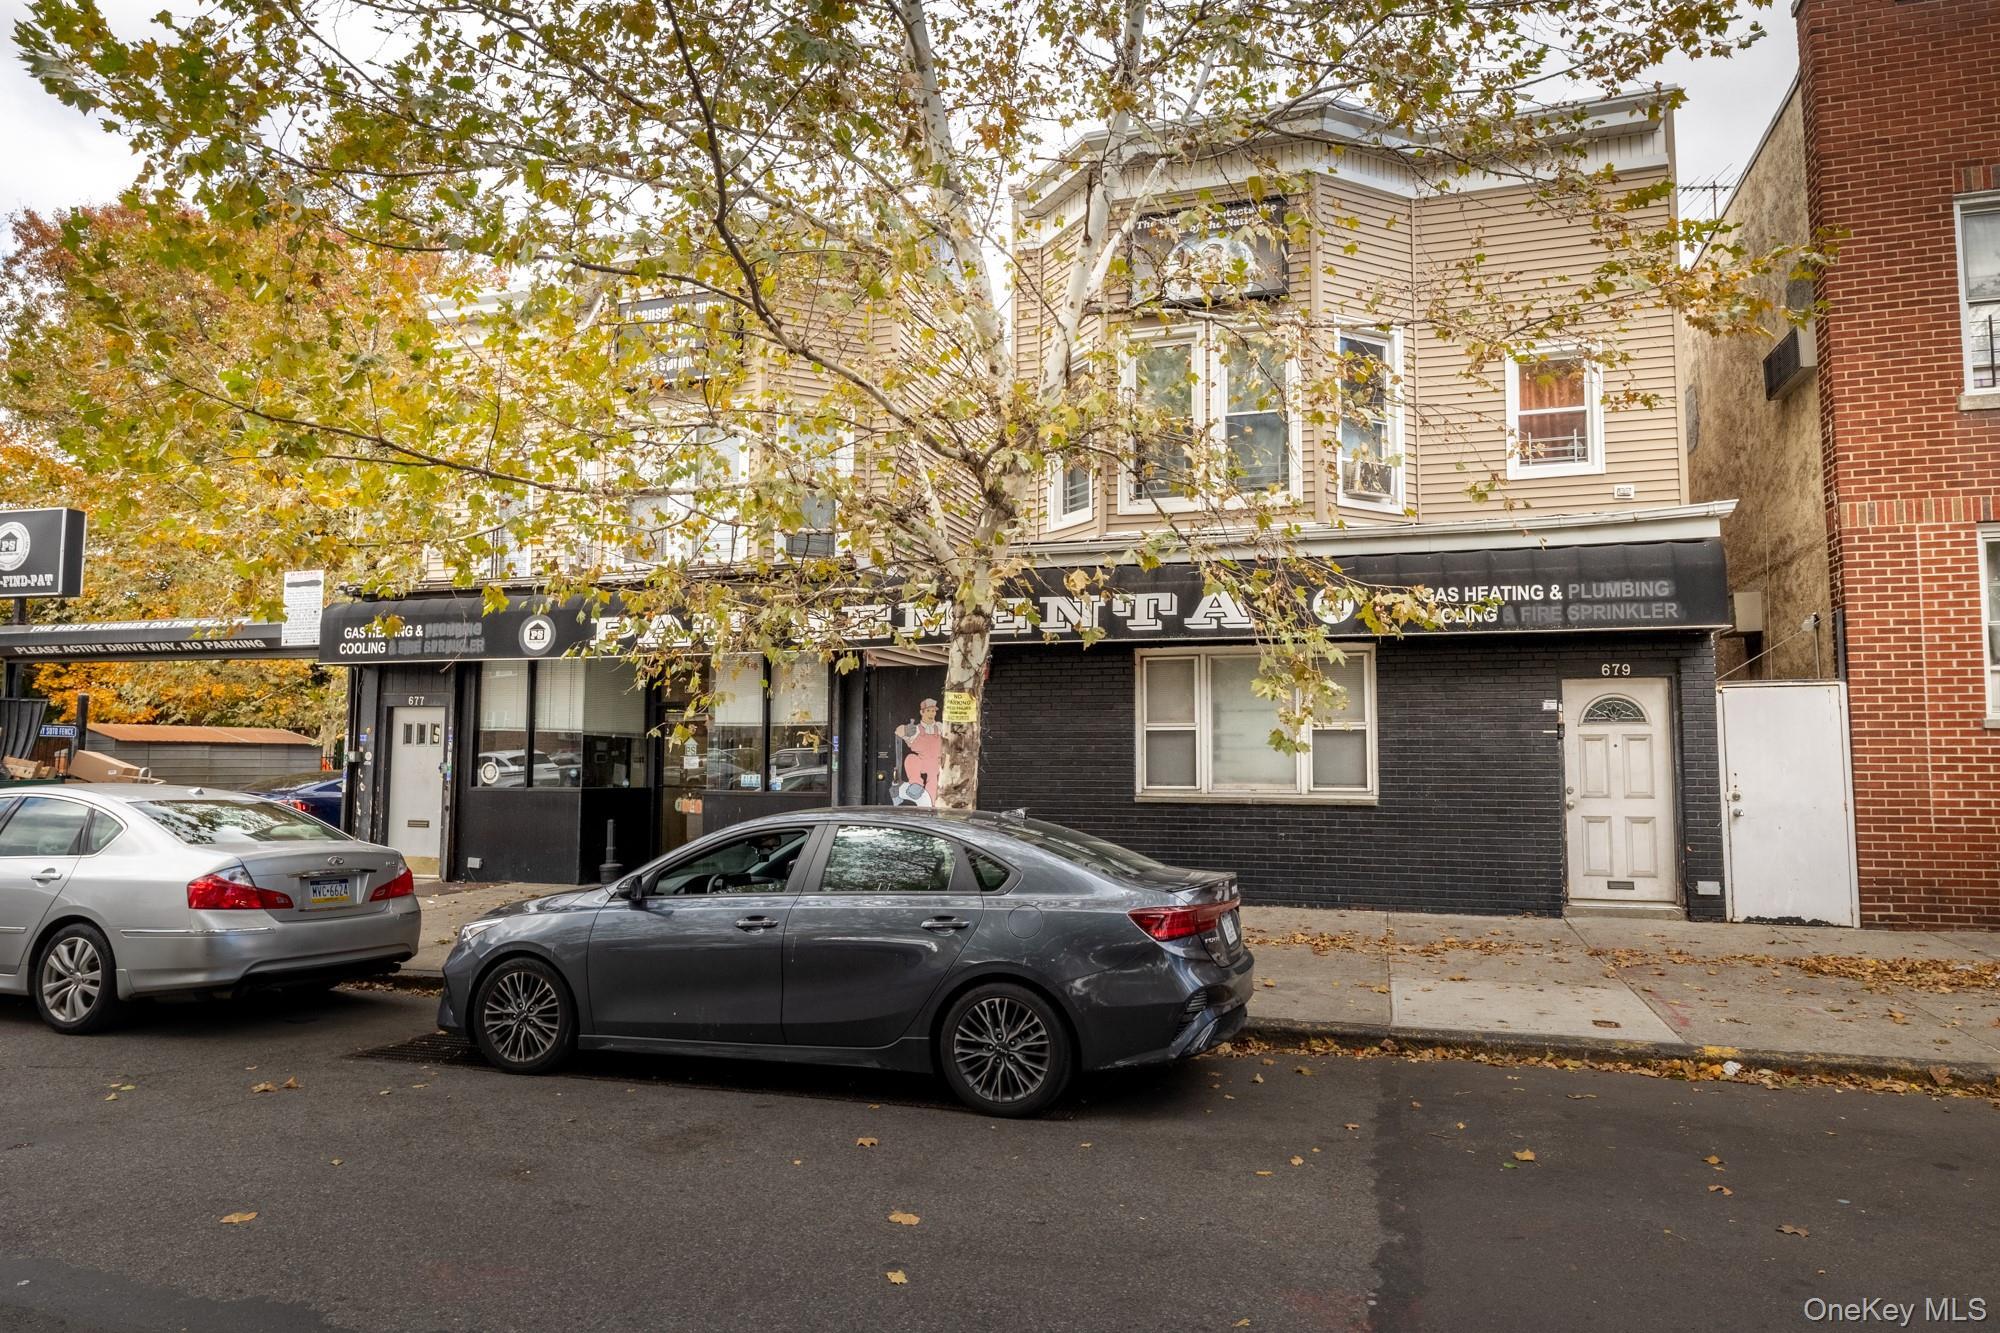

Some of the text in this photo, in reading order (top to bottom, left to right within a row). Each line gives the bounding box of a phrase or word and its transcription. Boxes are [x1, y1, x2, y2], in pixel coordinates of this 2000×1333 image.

[1464, 585, 1544, 601] HEATING
[1550, 584, 1563, 600] &
[1568, 580, 1670, 599] PLUMBING
[1567, 602, 1678, 621] SPRINKLER
[54, 623, 86, 632] BEST
[86, 621, 149, 630] PLUMBER
[415, 624, 423, 637] &
[14, 645, 62, 655] PLEASE
[62, 644, 106, 653] ACTIVE
[105, 642, 146, 652] DRIVE
[182, 641, 203, 650] NO
[202, 639, 267, 650] PARKING
[339, 641, 386, 655] COOLING
[1601, 664, 1631, 676] 679
[408, 696, 424, 705] 677
